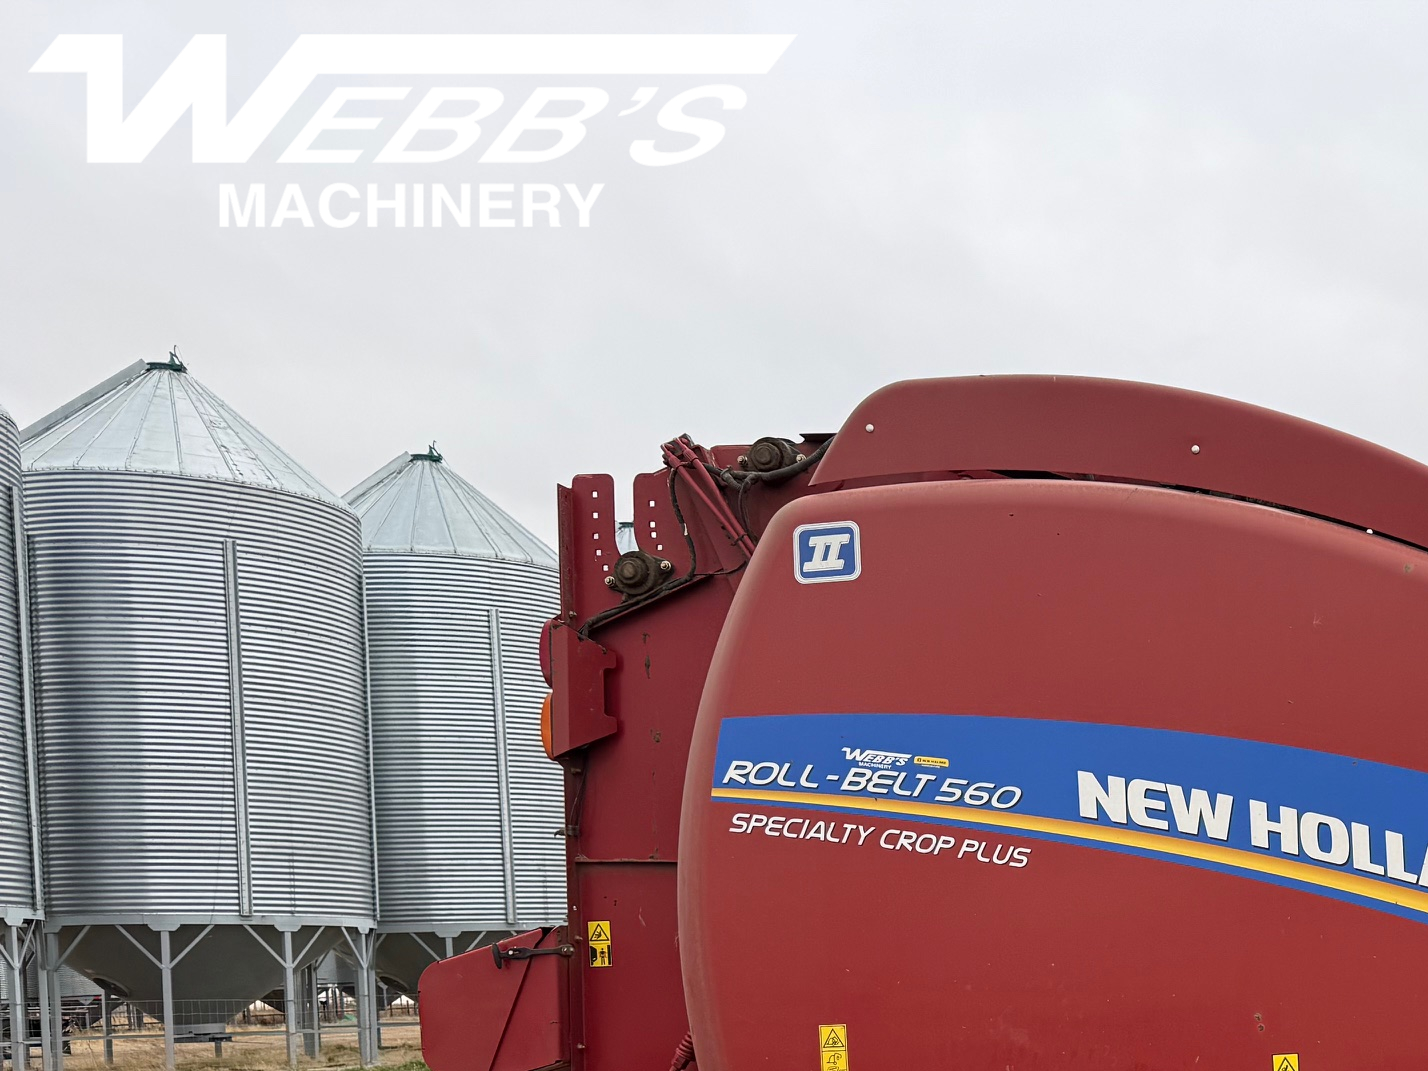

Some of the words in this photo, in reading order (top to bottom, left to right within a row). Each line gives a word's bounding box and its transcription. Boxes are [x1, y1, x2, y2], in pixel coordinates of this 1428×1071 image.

[841, 746, 913, 767] WEBB'S
[935, 778, 1023, 810] 560
[1077, 770, 1234, 842] NEW
[729, 812, 876, 847] SPECIALTY
[879, 828, 956, 857] CROP
[957, 838, 1032, 869] PLUS
